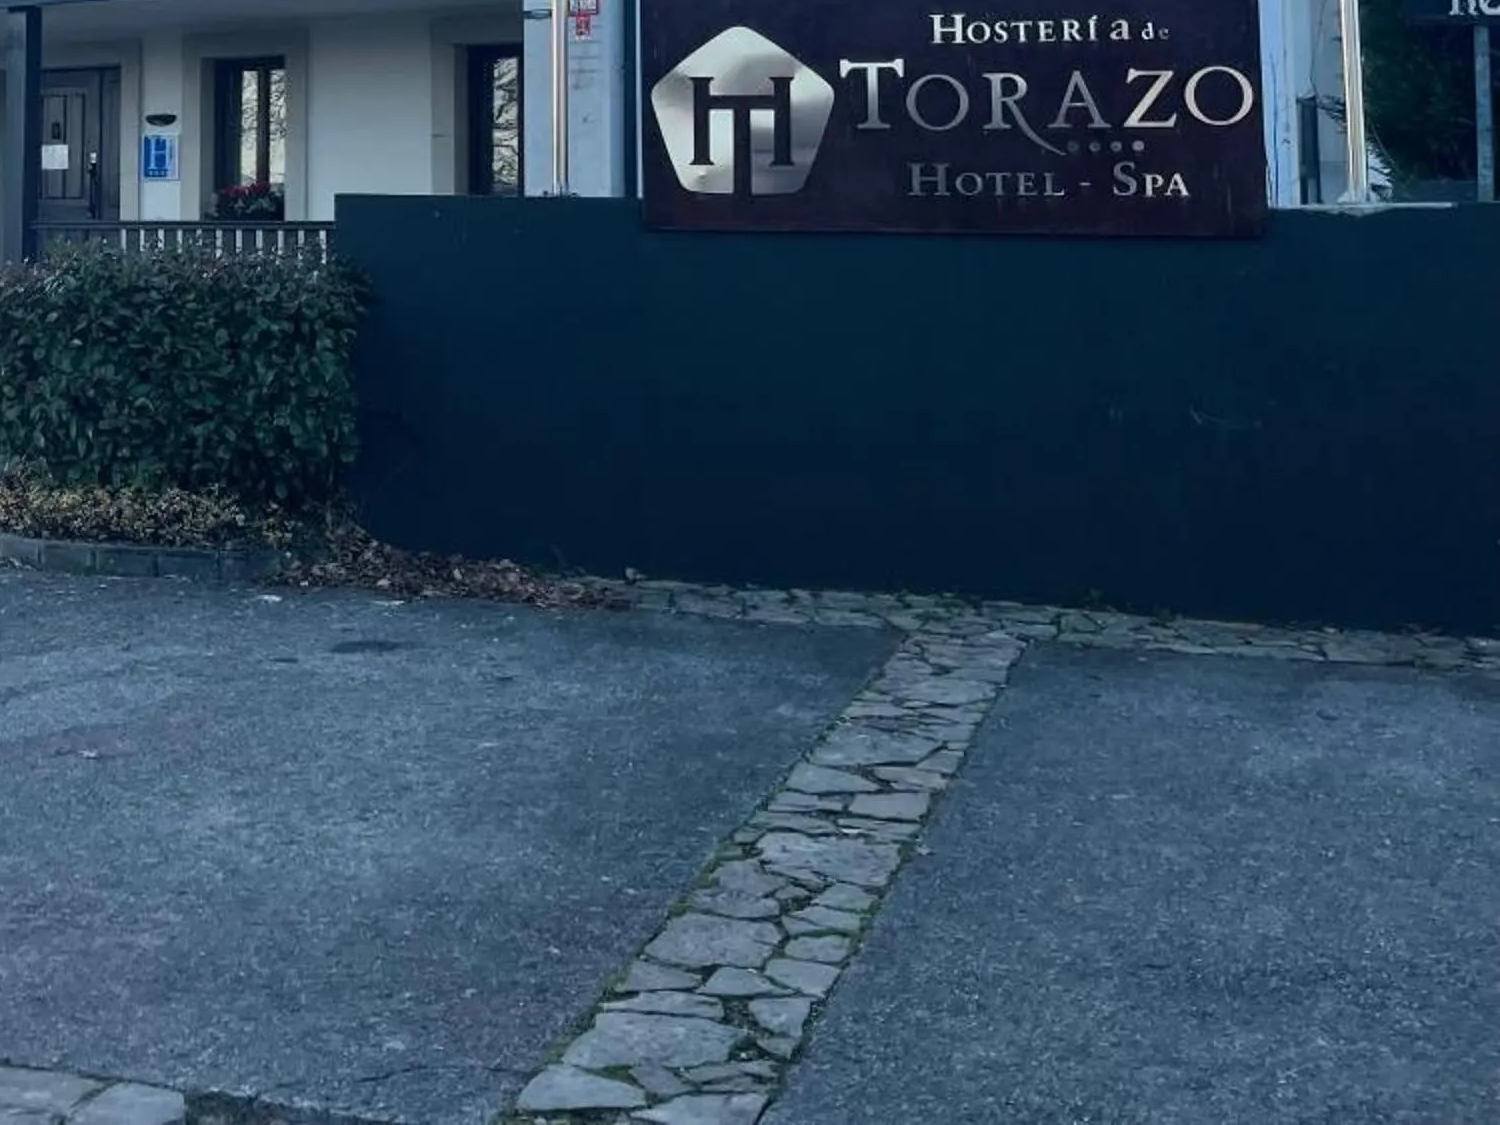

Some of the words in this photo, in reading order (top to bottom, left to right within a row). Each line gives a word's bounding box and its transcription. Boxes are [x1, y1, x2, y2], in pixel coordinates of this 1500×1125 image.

[839, 58, 1254, 156] TORAZO
[907, 162, 1065, 197] HOTEL
[1112, 161, 1190, 197] SPA
